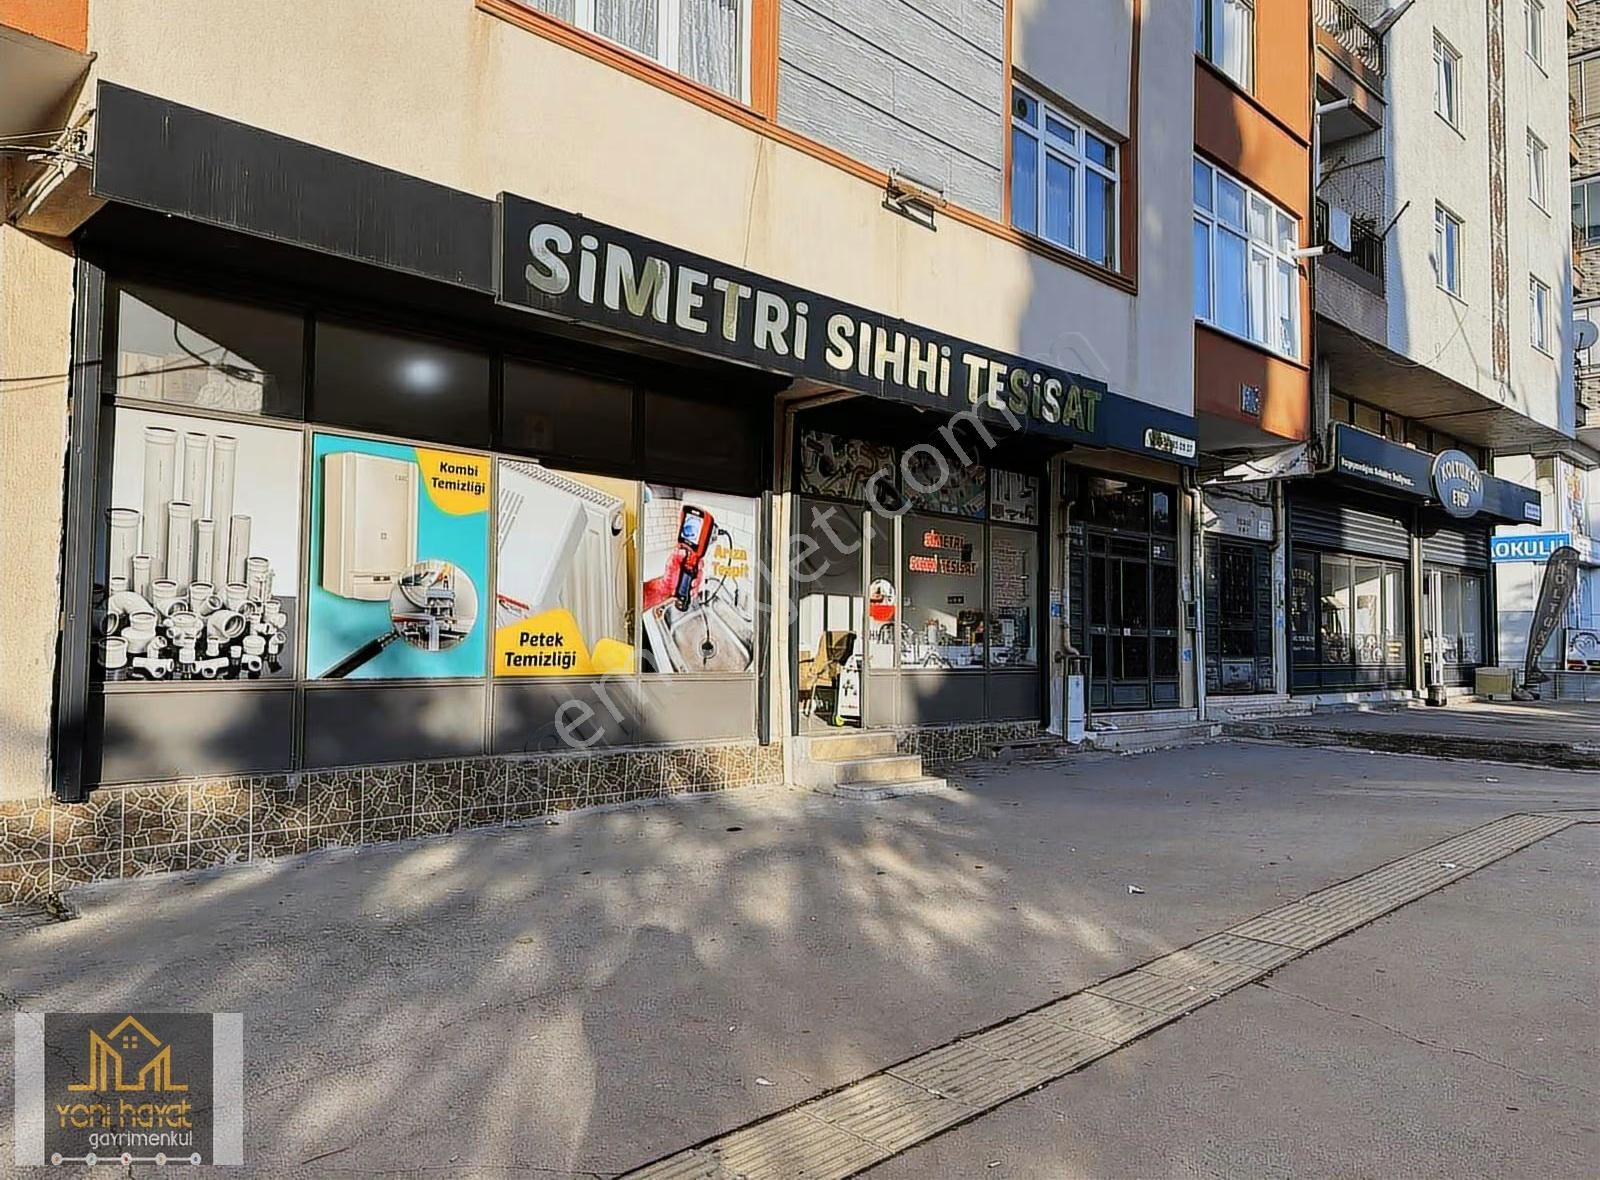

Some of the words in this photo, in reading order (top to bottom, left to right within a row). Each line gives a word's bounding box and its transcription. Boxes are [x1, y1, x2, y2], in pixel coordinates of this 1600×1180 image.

[439, 461, 479, 477] Kombi
[431, 477, 486, 495] Temizliği
[519, 632, 563, 648] Petek
[504, 651, 577, 670] Temizliği
